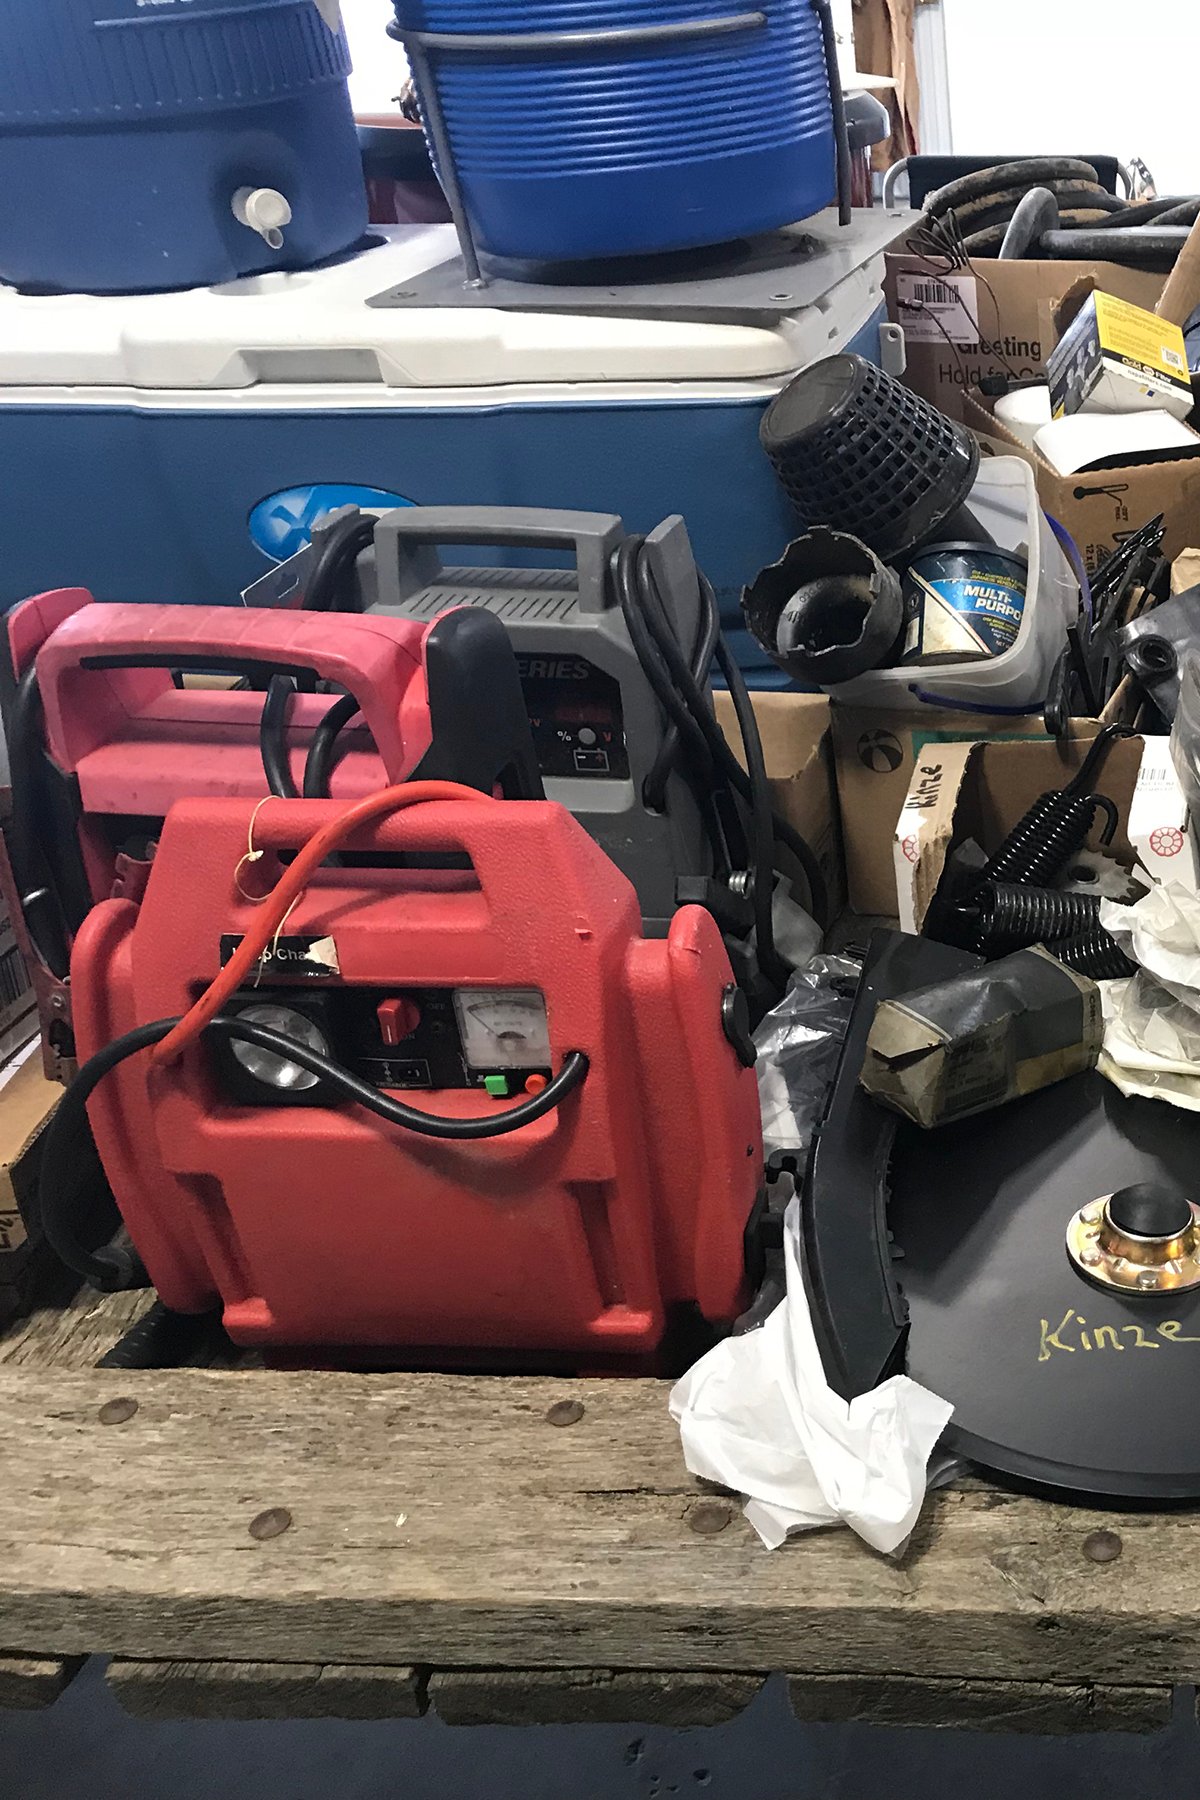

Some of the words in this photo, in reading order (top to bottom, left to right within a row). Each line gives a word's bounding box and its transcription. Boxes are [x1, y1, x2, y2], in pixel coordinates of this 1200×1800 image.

[939, 364, 981, 386] Hold
[965, 584, 1012, 603] MULTI-
[975, 598, 1022, 622] PURPO
[518, 660, 590, 679] ERIES
